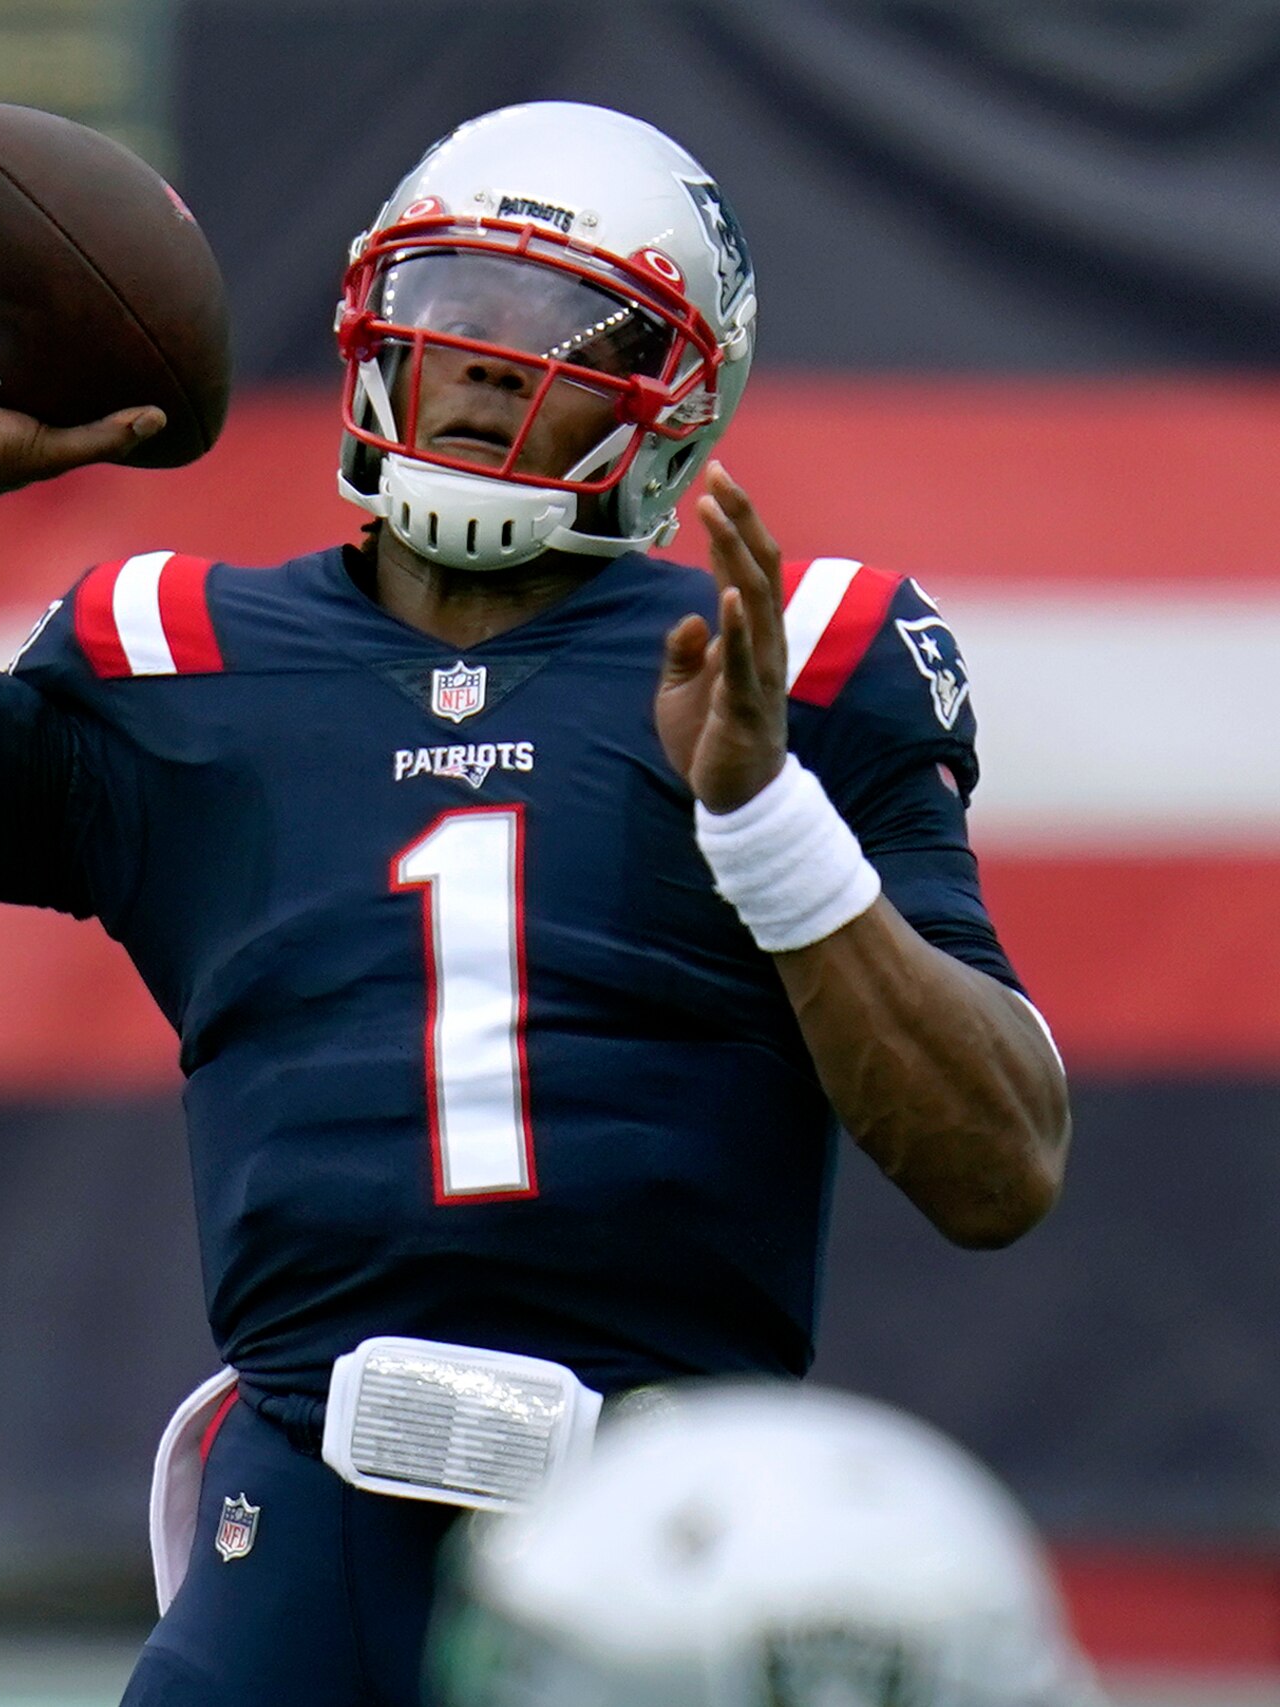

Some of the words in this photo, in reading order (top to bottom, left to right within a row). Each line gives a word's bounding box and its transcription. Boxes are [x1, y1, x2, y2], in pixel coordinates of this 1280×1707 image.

[497, 195, 574, 233] PATRIOTS
[441, 688, 475, 709] NFL
[394, 741, 535, 781] PATRIOTS
[389, 803, 539, 1206] 1
[221, 1522, 246, 1549] NFL
